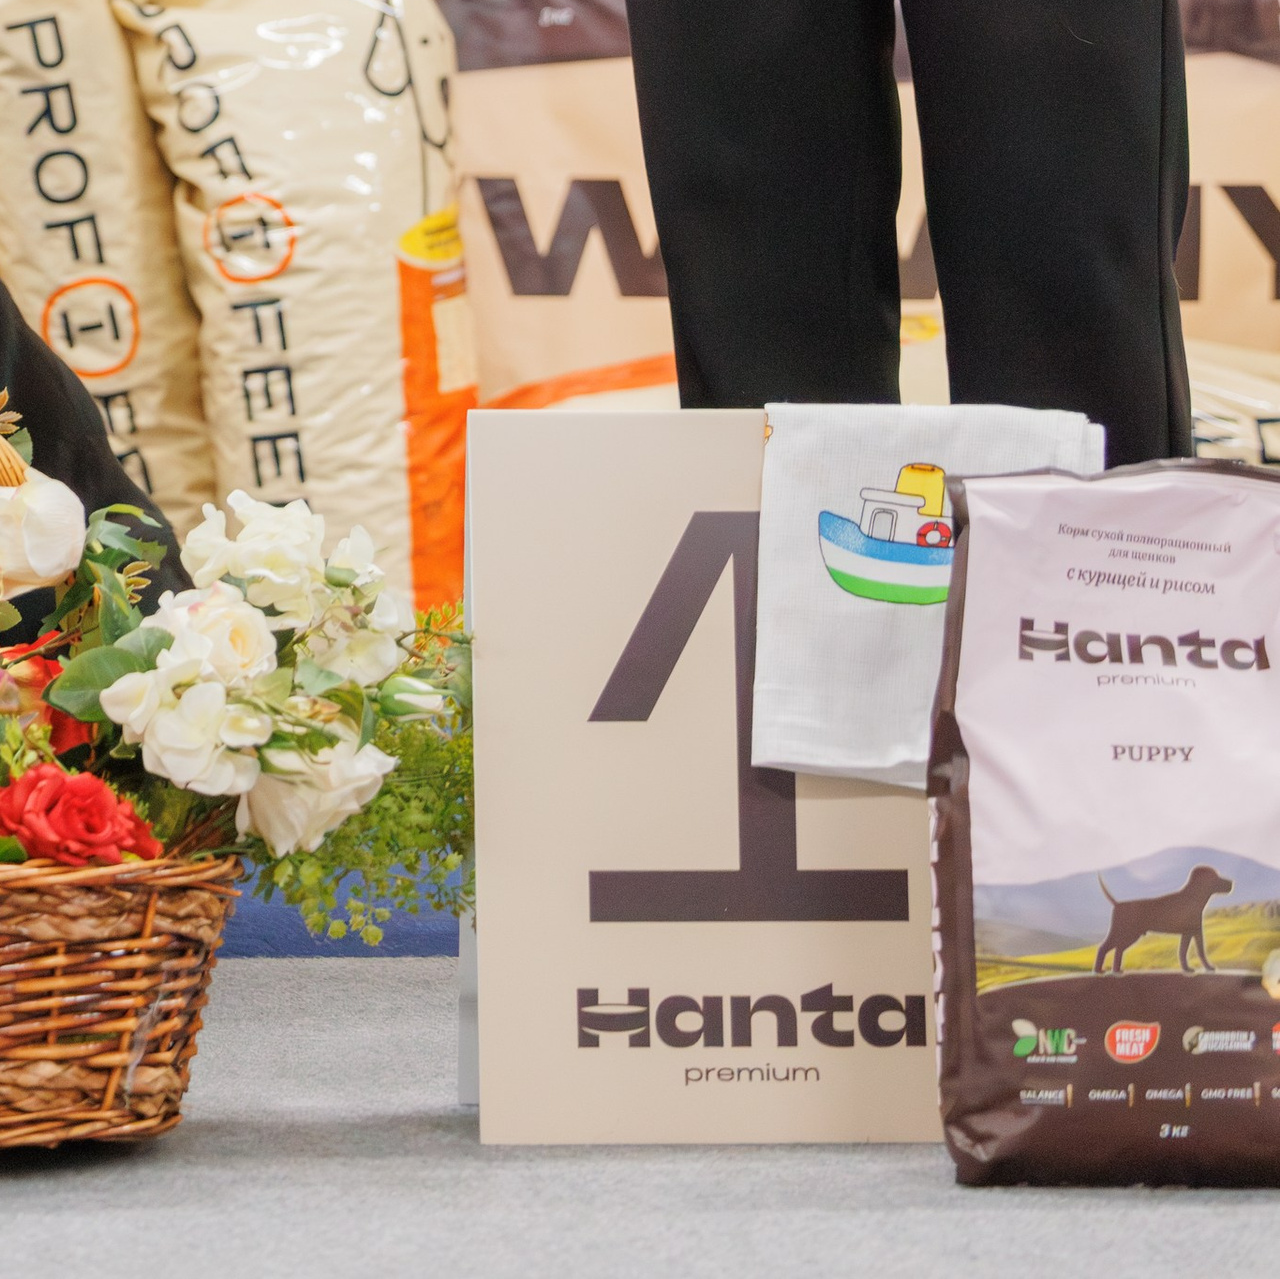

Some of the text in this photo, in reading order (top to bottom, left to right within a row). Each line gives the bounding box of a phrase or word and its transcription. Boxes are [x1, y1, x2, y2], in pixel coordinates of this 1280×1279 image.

[1057, 523, 1233, 554] Корм сухой полнорационный
[1108, 547, 1177, 564] для щенков
[1066, 567, 1216, 595] с курицей и рисом
[1018, 617, 1271, 671] Hanta
[1096, 672, 1197, 688] premium
[587, 510, 910, 923] 1
[1111, 744, 1194, 762] PUPPY
[577, 982, 927, 1048] Hanta
[1115, 1028, 1151, 1043] FRESH
[1115, 1042, 1145, 1057] MEAT
[684, 1062, 821, 1086] premium
[1088, 1089, 1127, 1101] OMEGA
[1145, 1089, 1184, 1101] OMEGA
